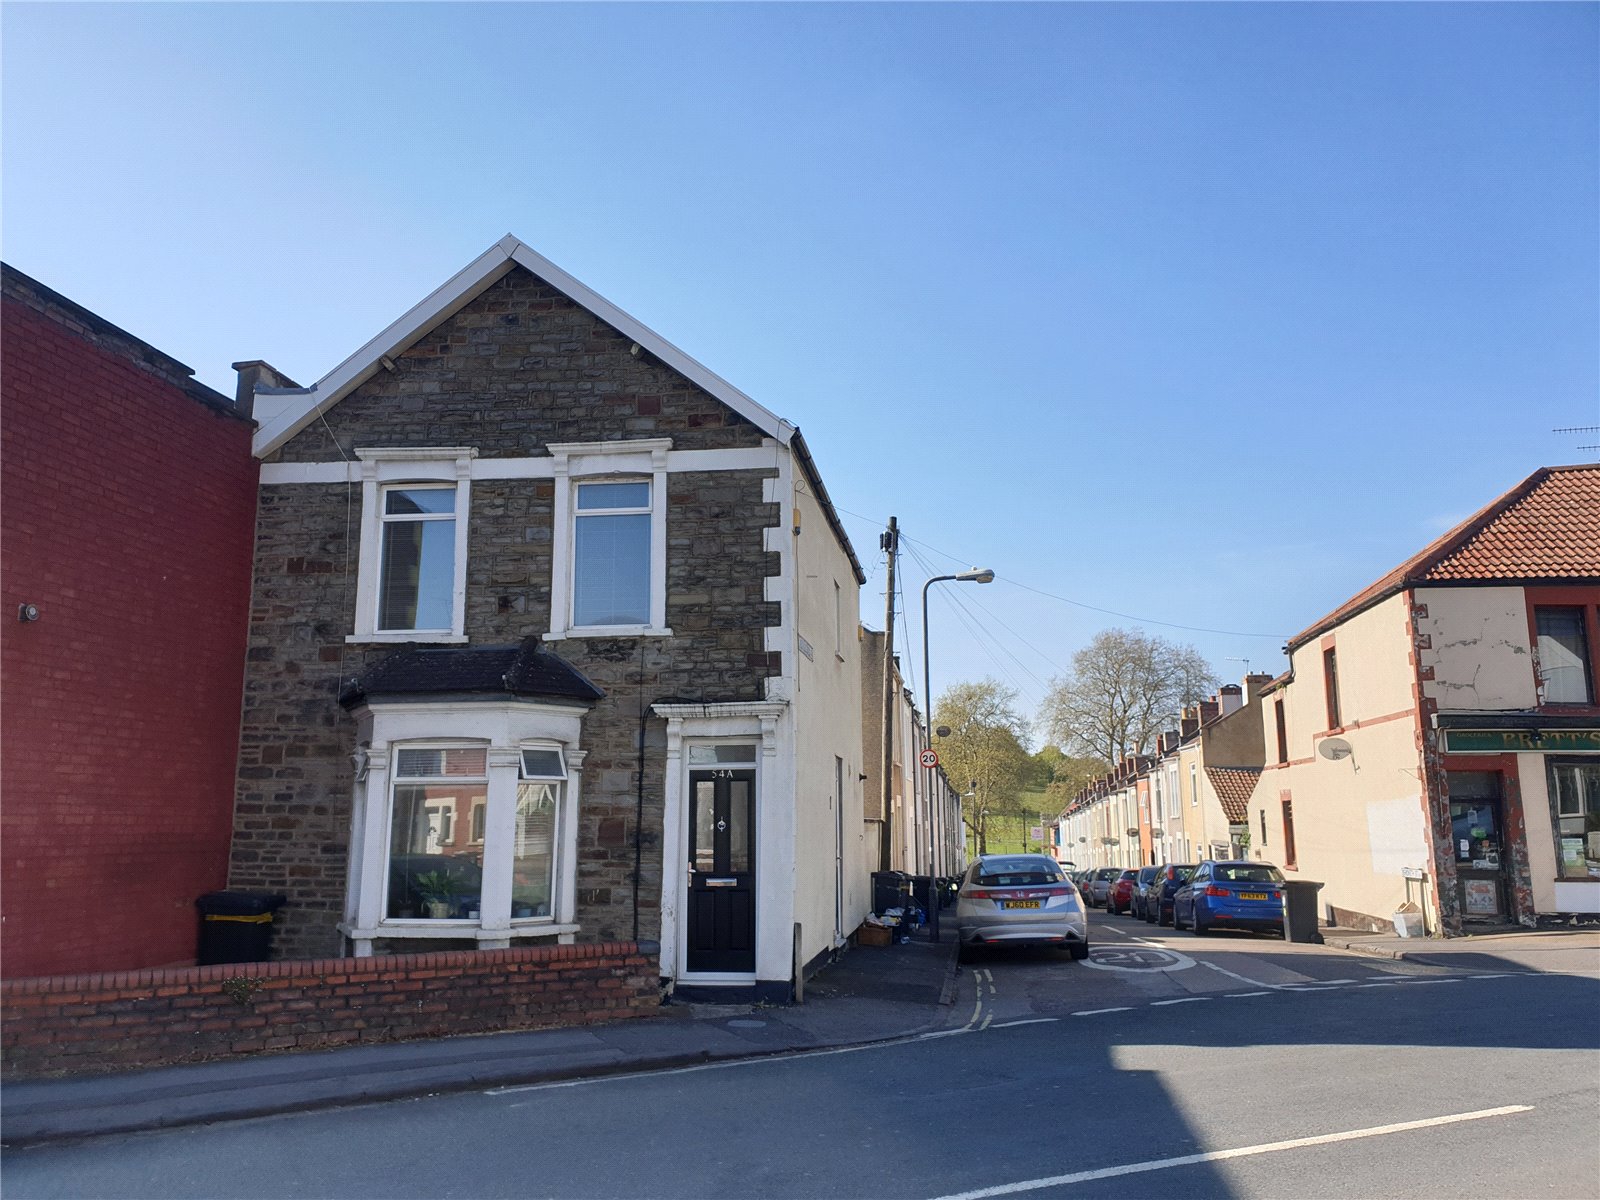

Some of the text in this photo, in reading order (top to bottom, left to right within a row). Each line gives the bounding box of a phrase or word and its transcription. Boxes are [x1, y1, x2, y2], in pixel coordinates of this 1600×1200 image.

[922, 754, 936, 763] 20
[711, 769, 734, 779] 54A
[1090, 951, 1174, 963] 20
